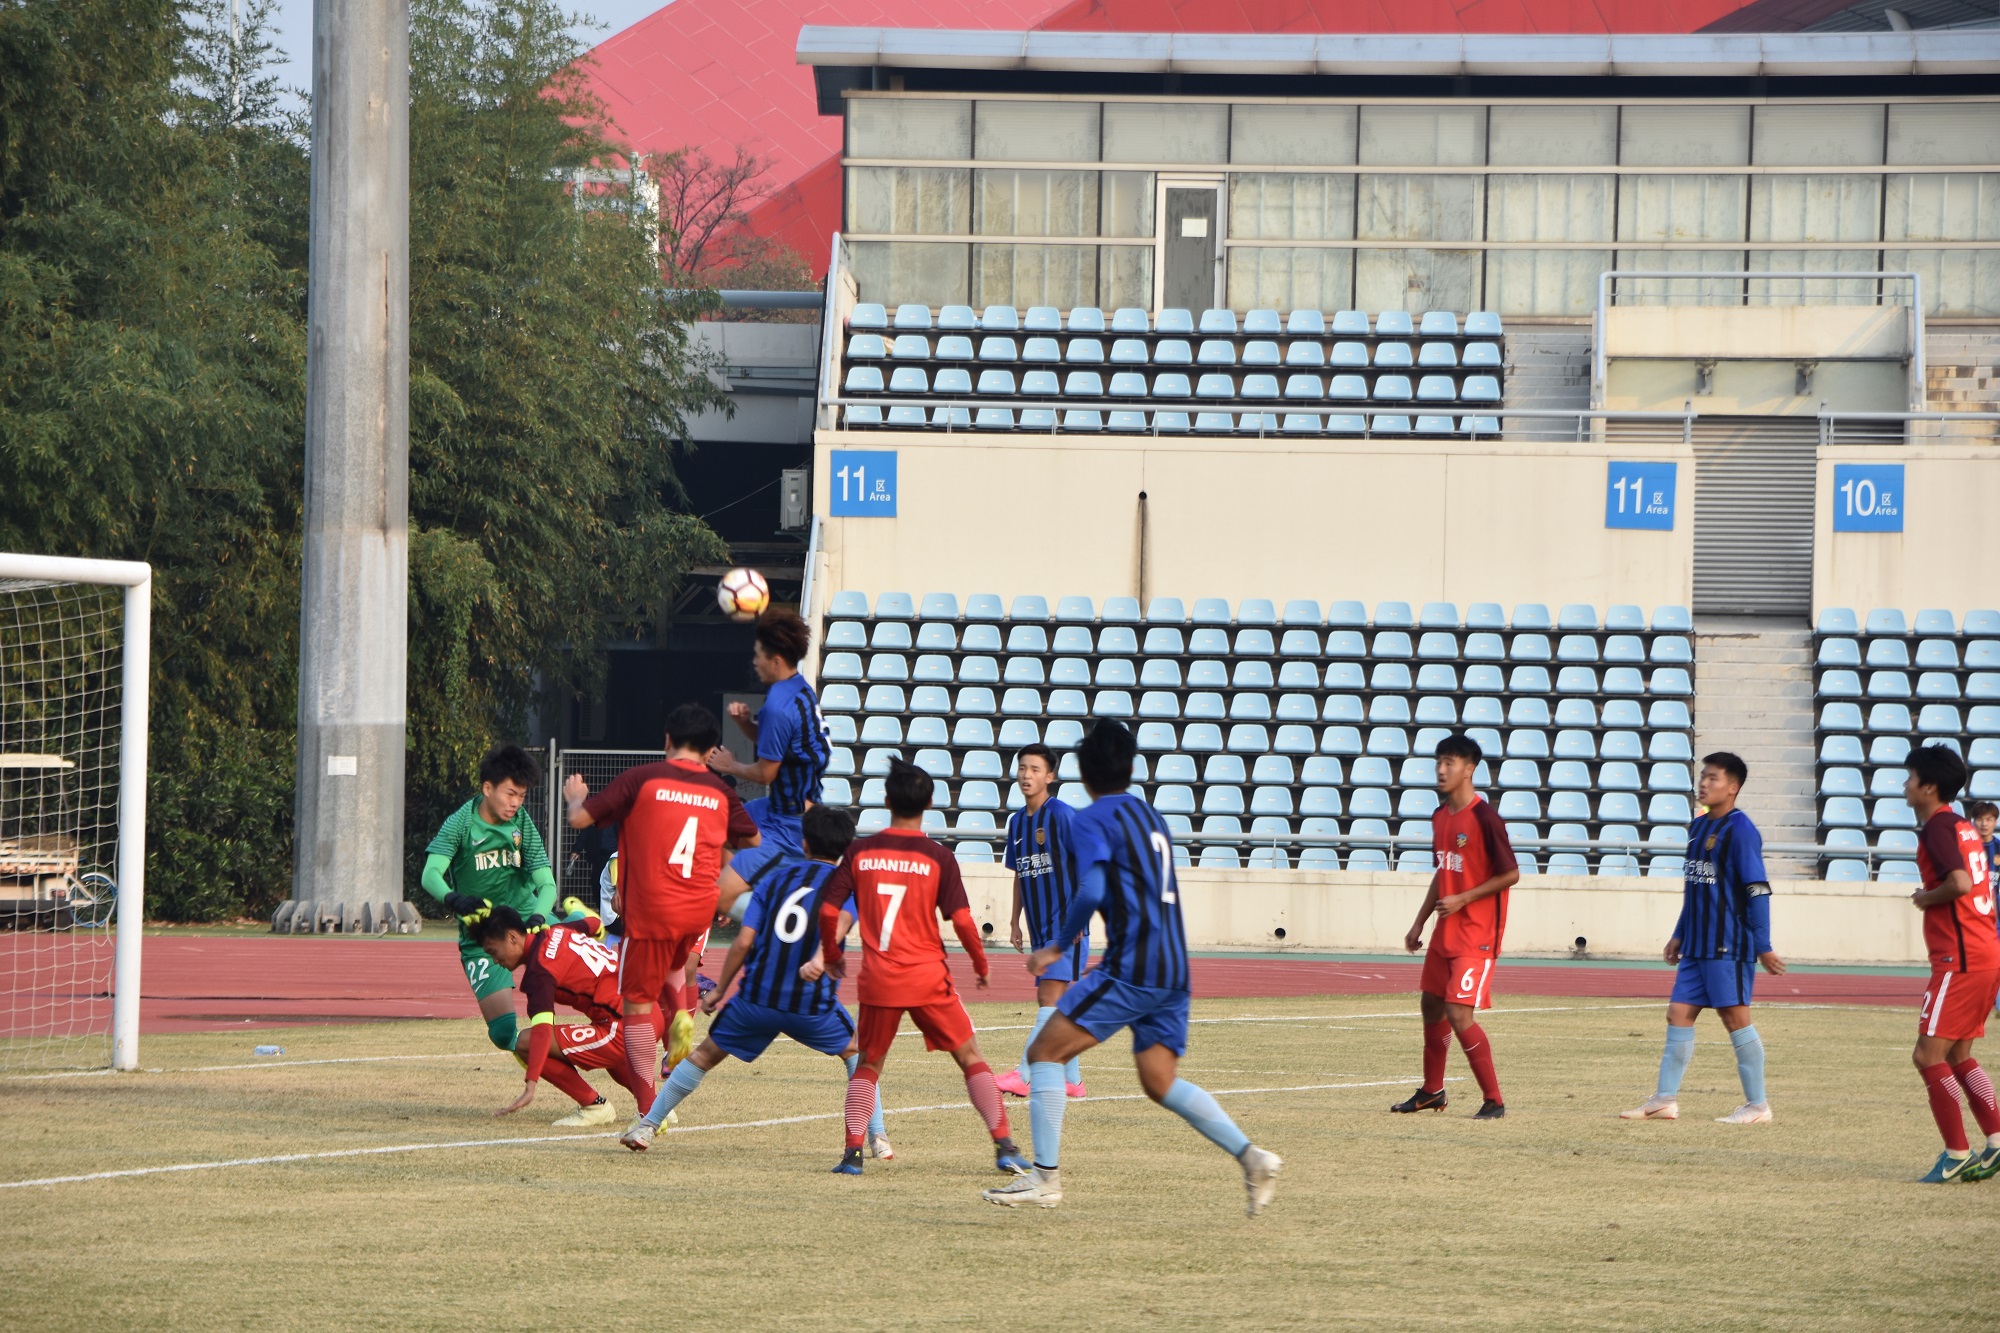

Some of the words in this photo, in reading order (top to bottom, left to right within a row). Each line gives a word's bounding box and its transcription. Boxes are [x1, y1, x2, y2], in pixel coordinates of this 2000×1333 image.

[837, 465, 865, 501] 11
[876, 479, 886, 492] 区
[1613, 477, 1643, 514] 11
[869, 492, 891, 502] Area
[1645, 504, 1668, 515] Area
[1653, 492, 1664, 505] 区
[1840, 479, 1876, 516] 10
[1881, 493, 1892, 506] 区
[1874, 506, 1897, 516] Area
[668, 816, 698, 878] 4
[1150, 831, 1176, 904] 2
[774, 887, 815, 944] 6
[877, 883, 908, 952] 7
[467, 958, 490, 985] 22
[1460, 968, 1475, 992] 6
[569, 1024, 596, 1042] 8
